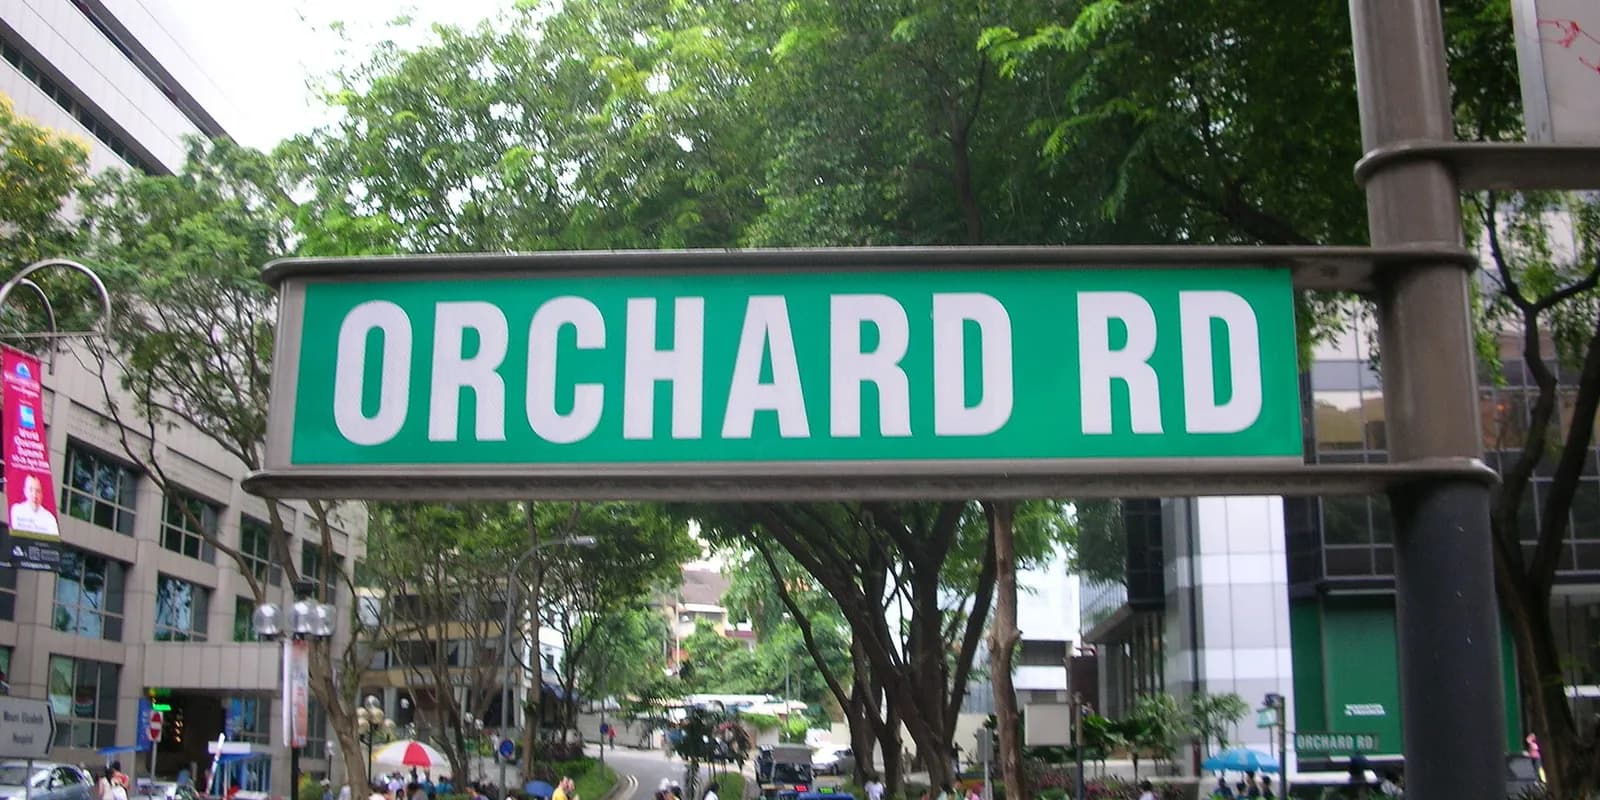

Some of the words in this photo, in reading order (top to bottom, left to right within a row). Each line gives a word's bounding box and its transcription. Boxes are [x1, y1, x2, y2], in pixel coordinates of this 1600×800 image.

[333, 292, 1013, 446] ORCHARD
[1076, 290, 1263, 434] RD
[1297, 735, 1353, 750] ORCHARD
[1357, 735, 1373, 750] RD
